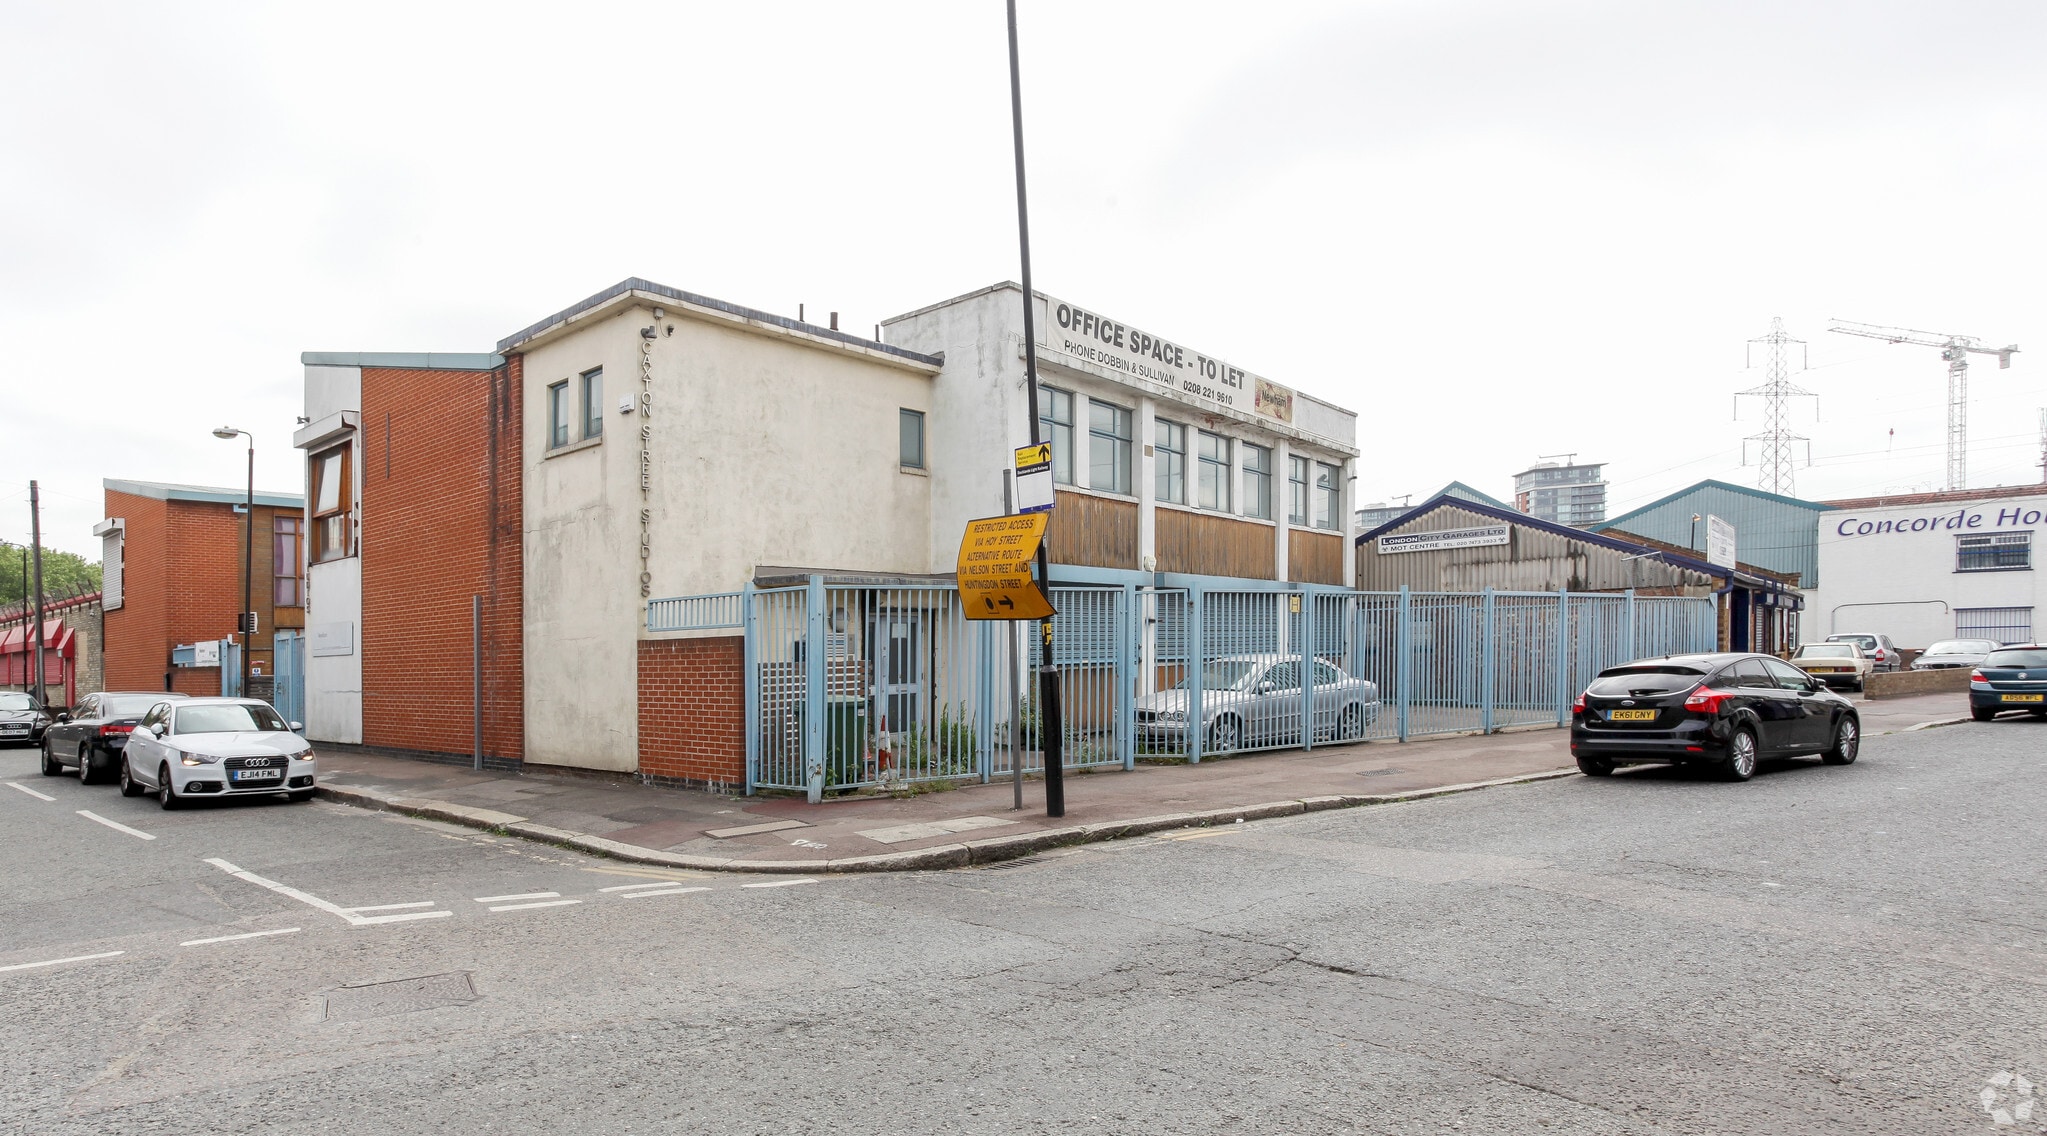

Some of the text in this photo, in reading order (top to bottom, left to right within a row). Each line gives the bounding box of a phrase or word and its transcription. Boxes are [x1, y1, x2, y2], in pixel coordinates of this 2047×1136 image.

[1056, 303, 1125, 348] OFFICE
[1129, 330, 1183, 369] SPACE
[1197, 355, 1217, 380] TO
[1221, 364, 1245, 390] LET
[1064, 340, 1233, 405] PHONE DOBBIN & SULLIVAN 0208 221 9610
[1261, 390, 1287, 408] Newham
[640, 342, 652, 598] CAXTON STREET STUDIOS
[974, 519, 1034, 533] RESTRICTED ACCESS
[1837, 507, 2047, 536] Concorde Ho
[975, 534, 1023, 546] VIA HOY STREET
[1382, 537, 1418, 545] LONDON
[1443, 531, 1485, 539] GARAGES
[967, 549, 1023, 561] ALTERNATIVE ROUTE
[969, 565, 990, 574] NELSON
[992, 564, 1012, 574] STREET
[1015, 562, 1028, 573] AND
[964, 579, 1022, 589] HUNTINGDON STREET
[1614, 711, 1652, 719] EK61 GNY
